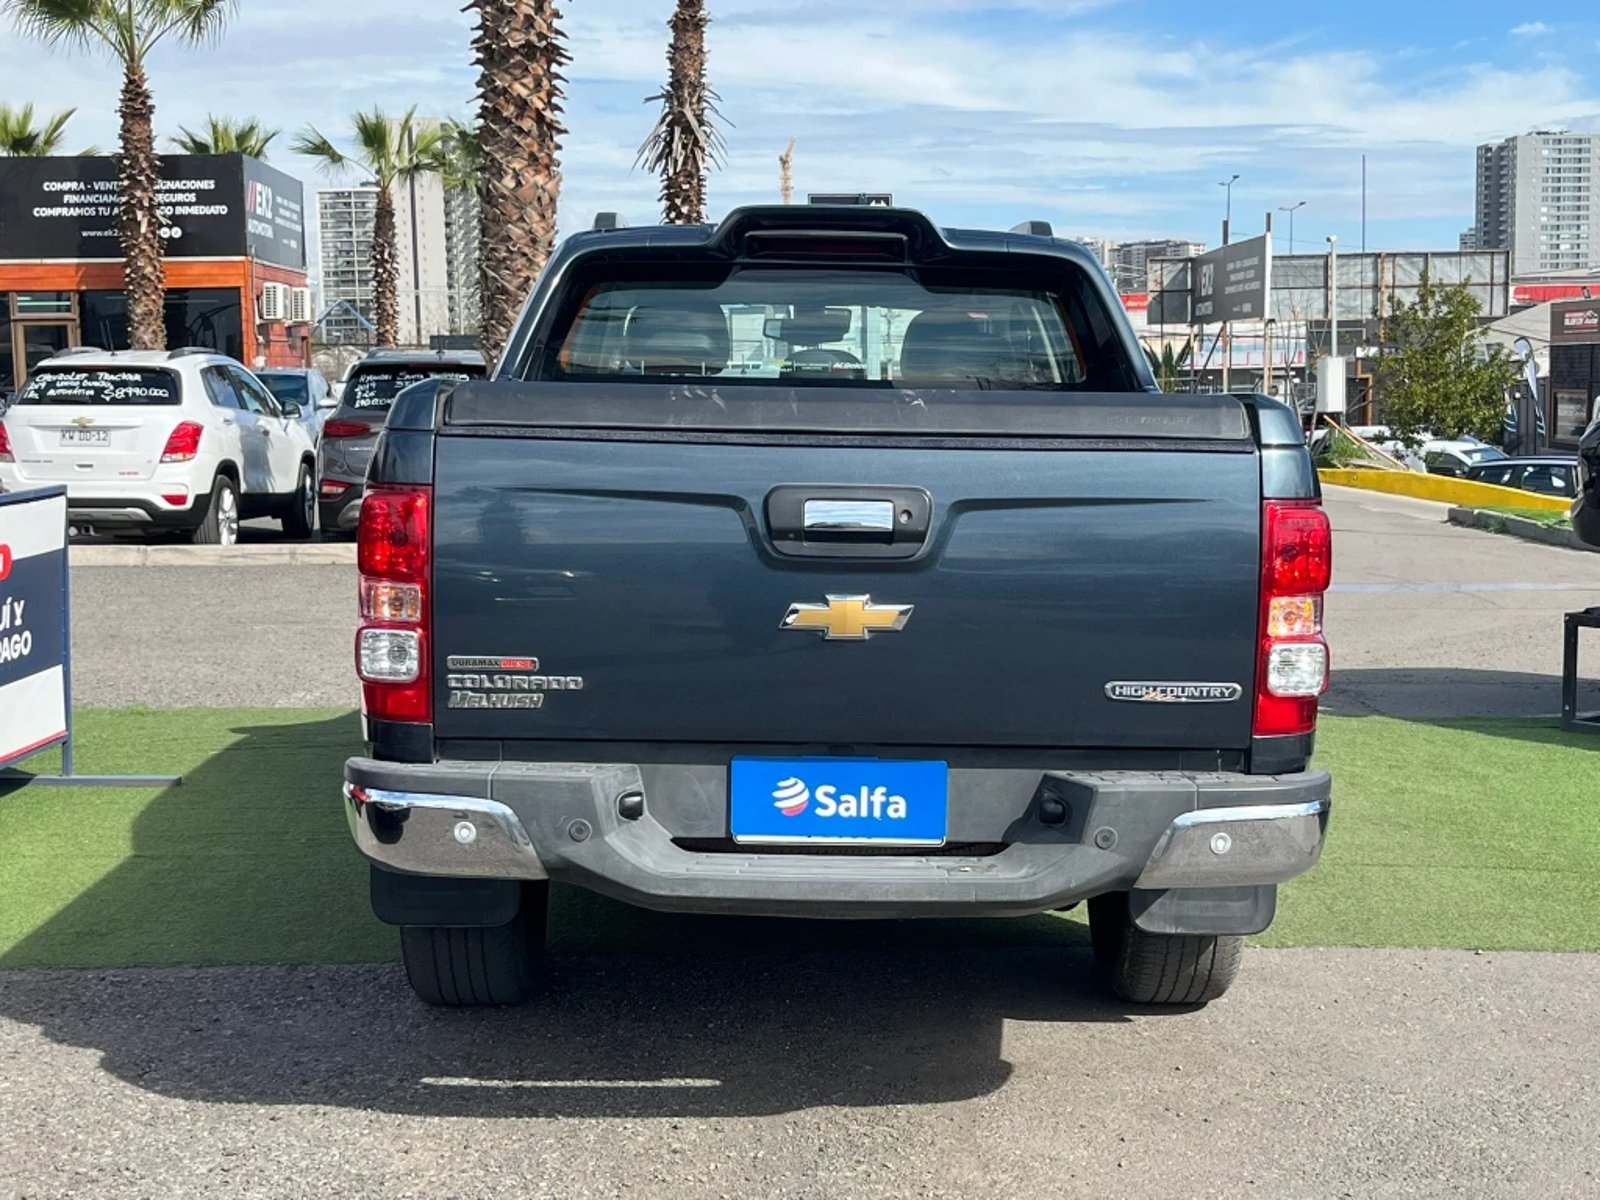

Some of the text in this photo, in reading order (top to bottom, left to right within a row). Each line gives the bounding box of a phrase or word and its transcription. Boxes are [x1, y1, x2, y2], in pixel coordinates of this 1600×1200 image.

[43, 181, 86, 191] COMPRA
[93, 181, 119, 190] VENT
[33, 207, 96, 217] COMPRAMOS
[98, 207, 110, 216] TU
[175, 205, 228, 215] INMEDIATO
[13, 599, 25, 626] Y
[0, 630, 32, 664] AGO
[451, 658, 500, 667] DURAMAX
[446, 674, 584, 690] COLORADO
[447, 690, 545, 708] MELHUISH
[814, 784, 907, 820] Salfa
